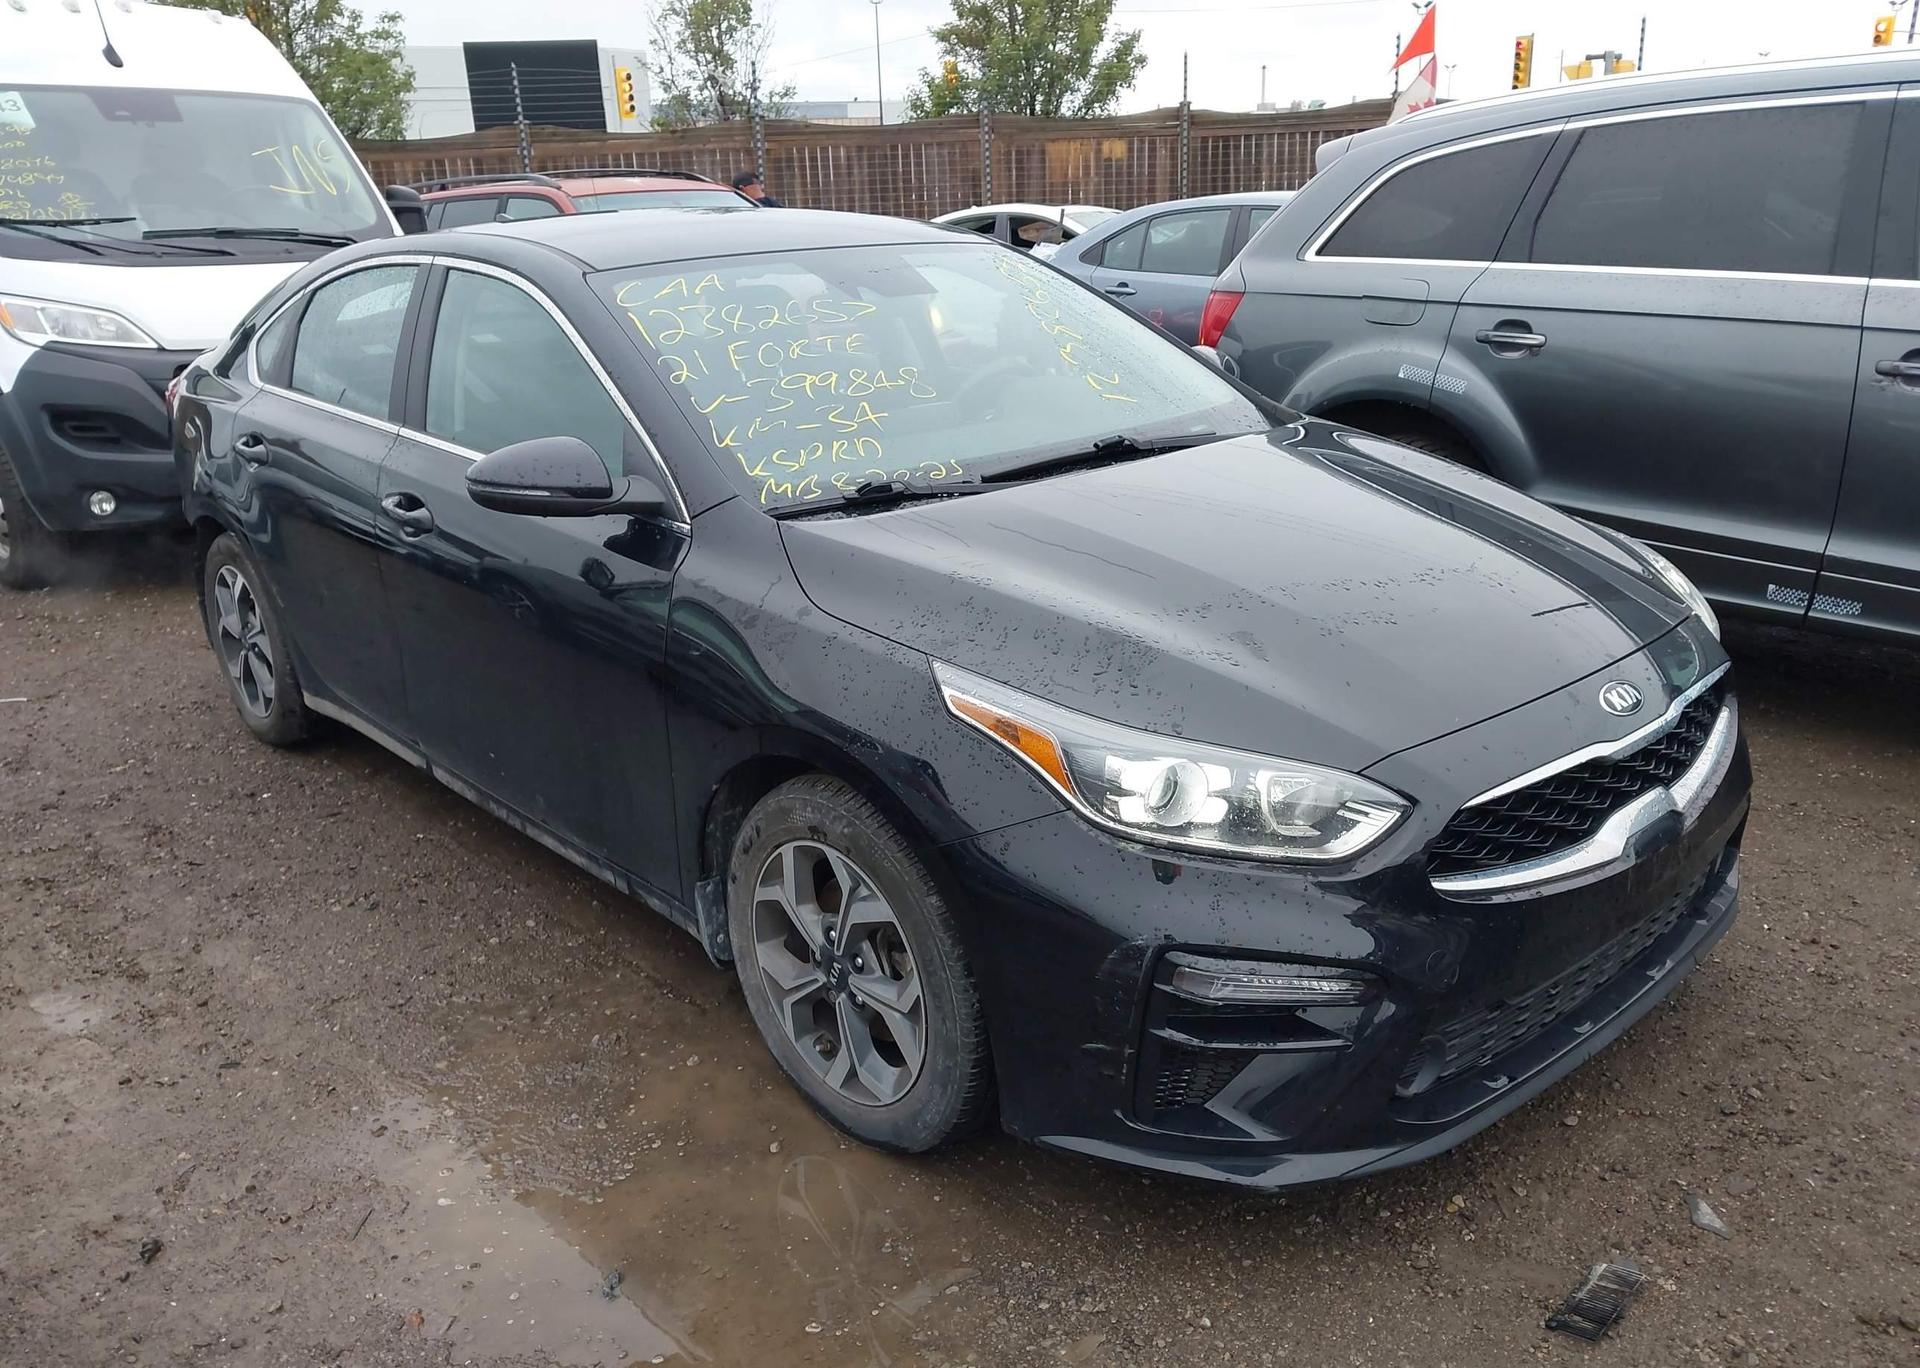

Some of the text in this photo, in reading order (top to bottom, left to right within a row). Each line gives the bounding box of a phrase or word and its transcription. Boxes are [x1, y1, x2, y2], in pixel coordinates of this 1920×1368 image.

[615, 273, 725, 308] CAA
[657, 333, 867, 385] 21 FORTE
[1604, 684, 1642, 711] KIA
